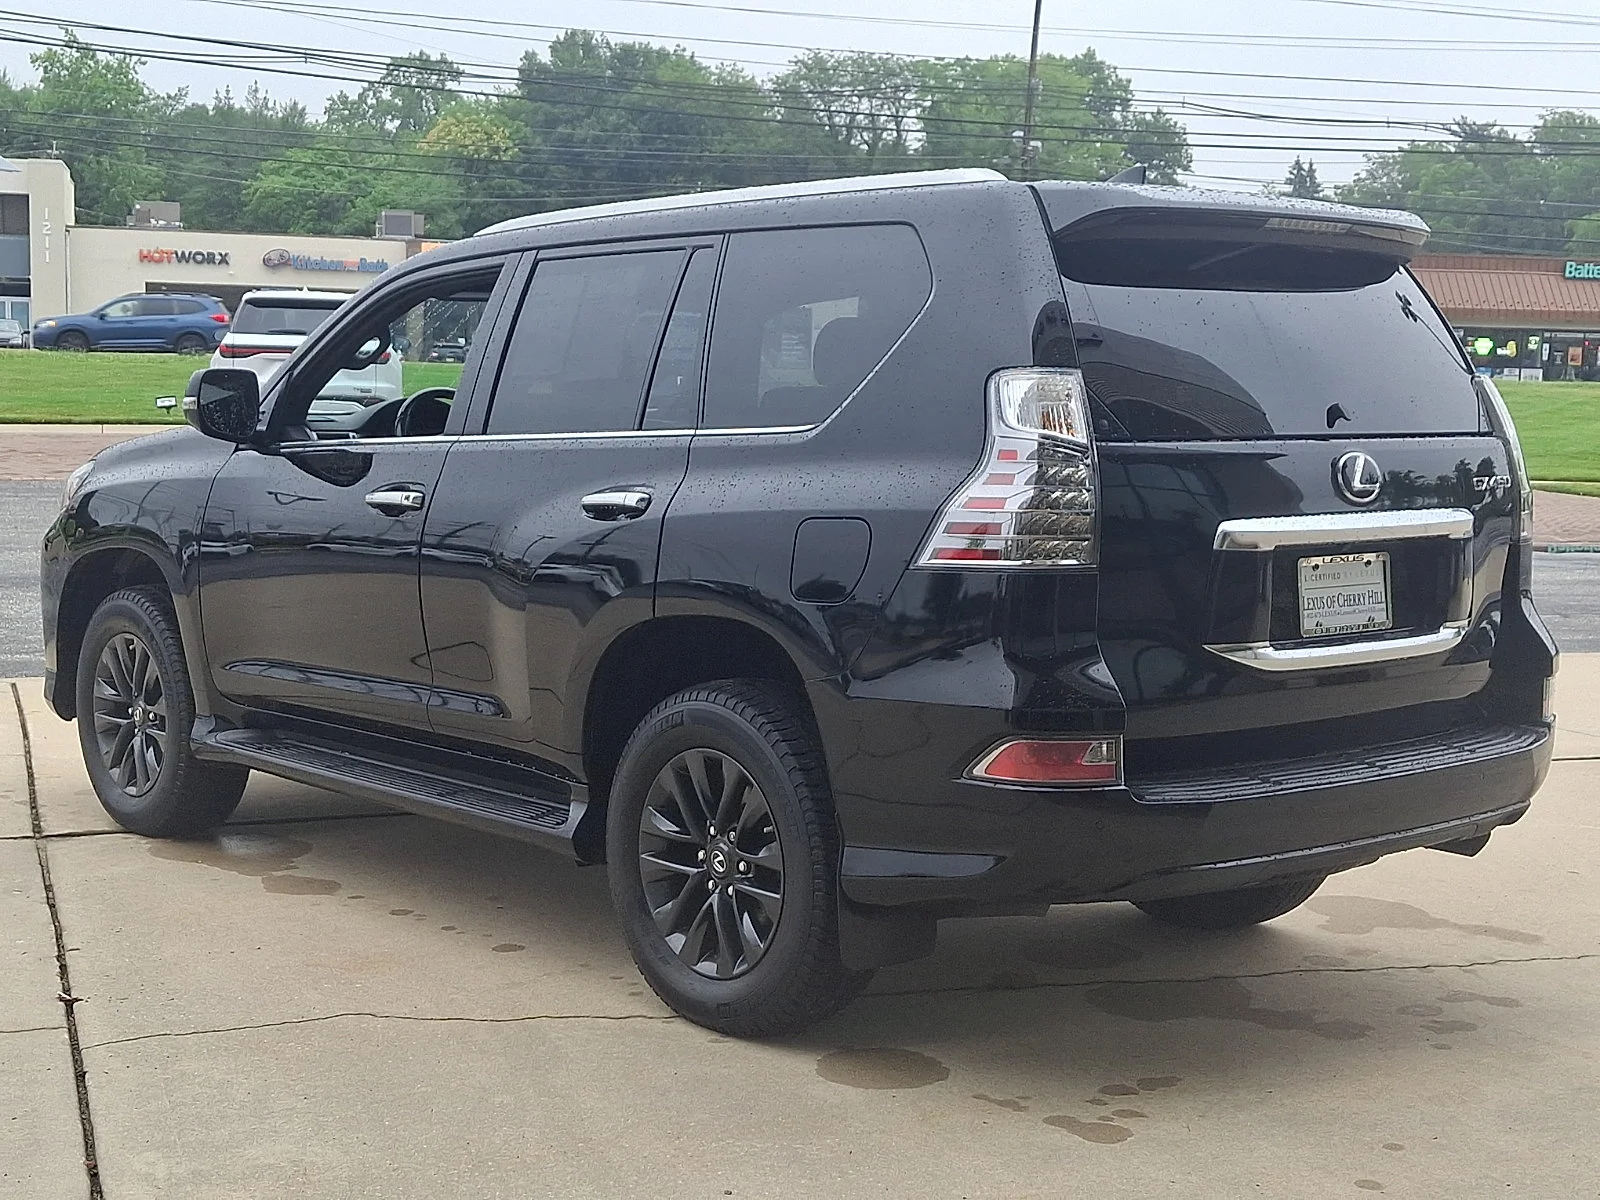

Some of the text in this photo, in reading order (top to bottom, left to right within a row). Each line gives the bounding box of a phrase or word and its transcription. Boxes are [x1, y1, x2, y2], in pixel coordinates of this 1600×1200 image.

[42, 207, 52, 263] 1211
[139, 248, 230, 265] HOTWORX
[291, 254, 344, 271] Kitchen
[1322, 554, 1365, 564] LEXUS
[1303, 590, 1384, 611] LEXUS OF CHERRY HILL
